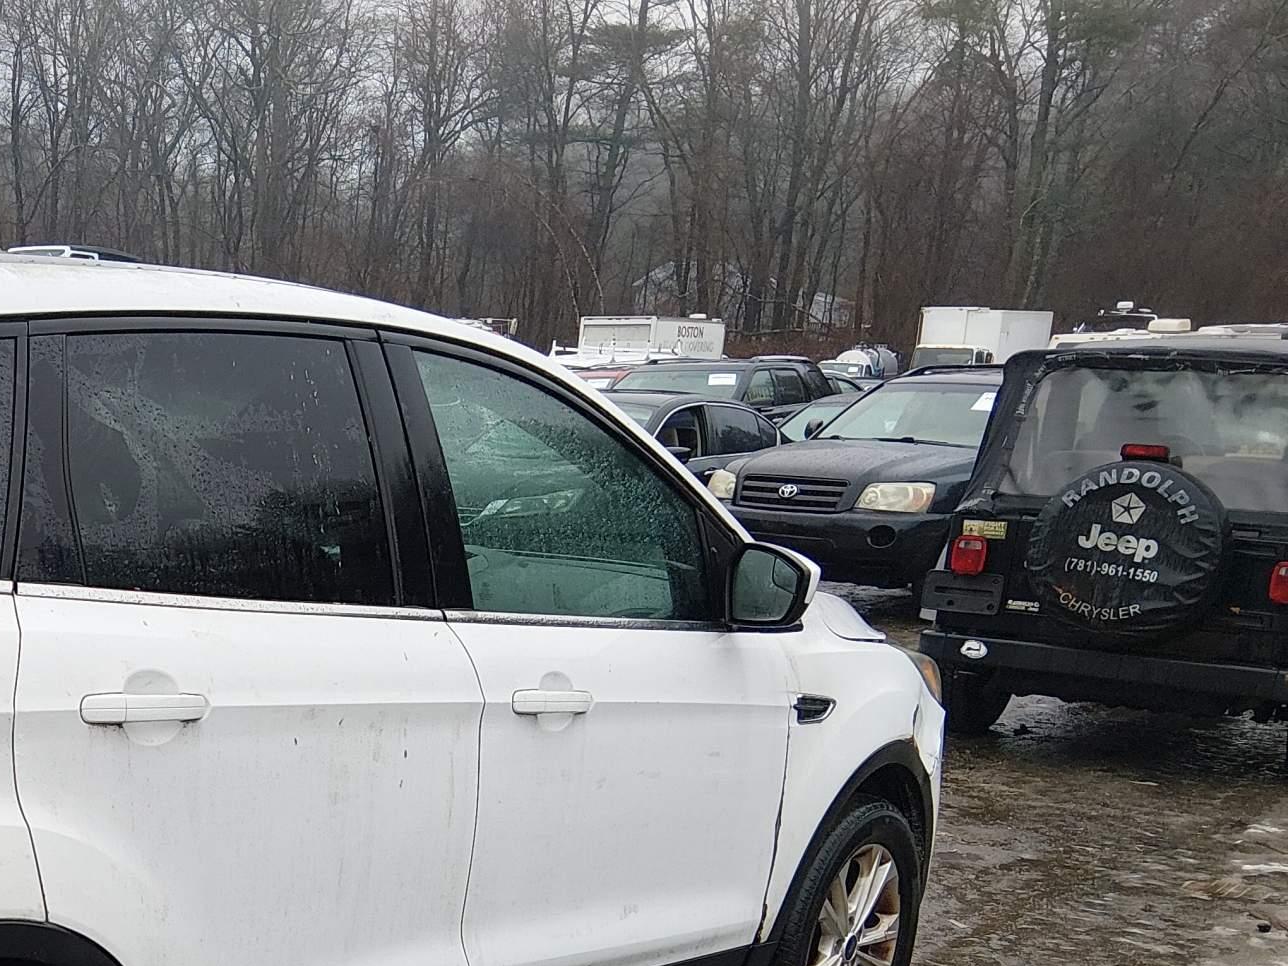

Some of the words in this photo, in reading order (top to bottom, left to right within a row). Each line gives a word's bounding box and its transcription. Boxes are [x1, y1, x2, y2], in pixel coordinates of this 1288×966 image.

[677, 325, 705, 339] BOSTON
[1061, 467, 1200, 525] RANDOLPH
[1078, 524, 1159, 563] Jeep
[1064, 557, 1159, 583] (781)-961-1550
[1058, 592, 1142, 621] CHRYSLER
